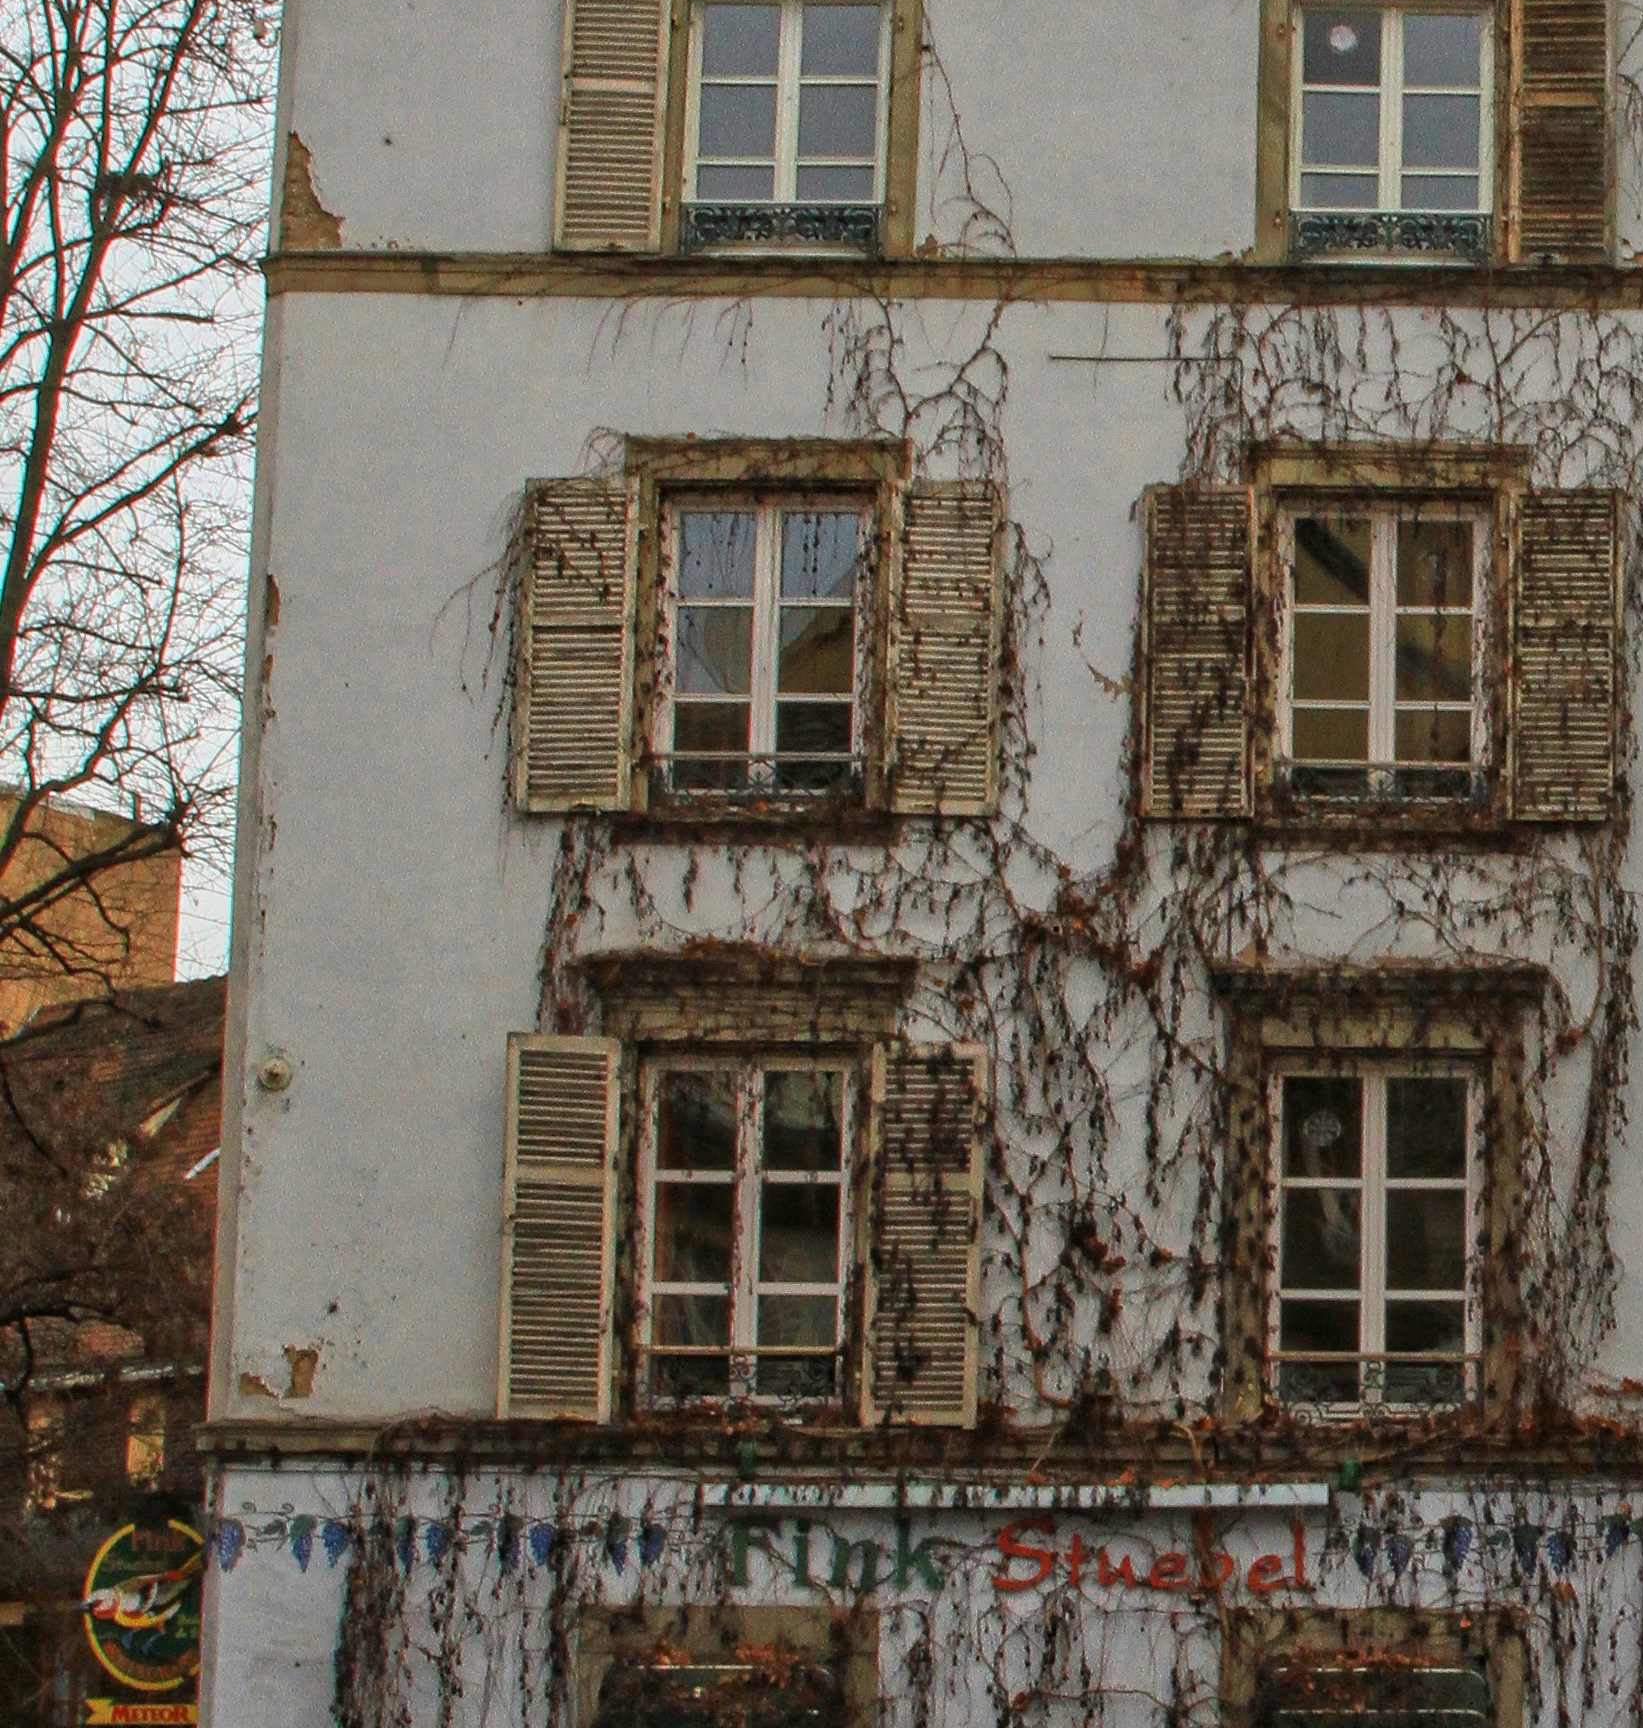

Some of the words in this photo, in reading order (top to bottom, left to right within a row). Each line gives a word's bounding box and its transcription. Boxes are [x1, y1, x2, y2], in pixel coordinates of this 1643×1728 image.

[730, 1518, 945, 1592] Fink
[991, 1516, 1308, 1591] Stuebel
[112, 1704, 189, 1722] METEOR
